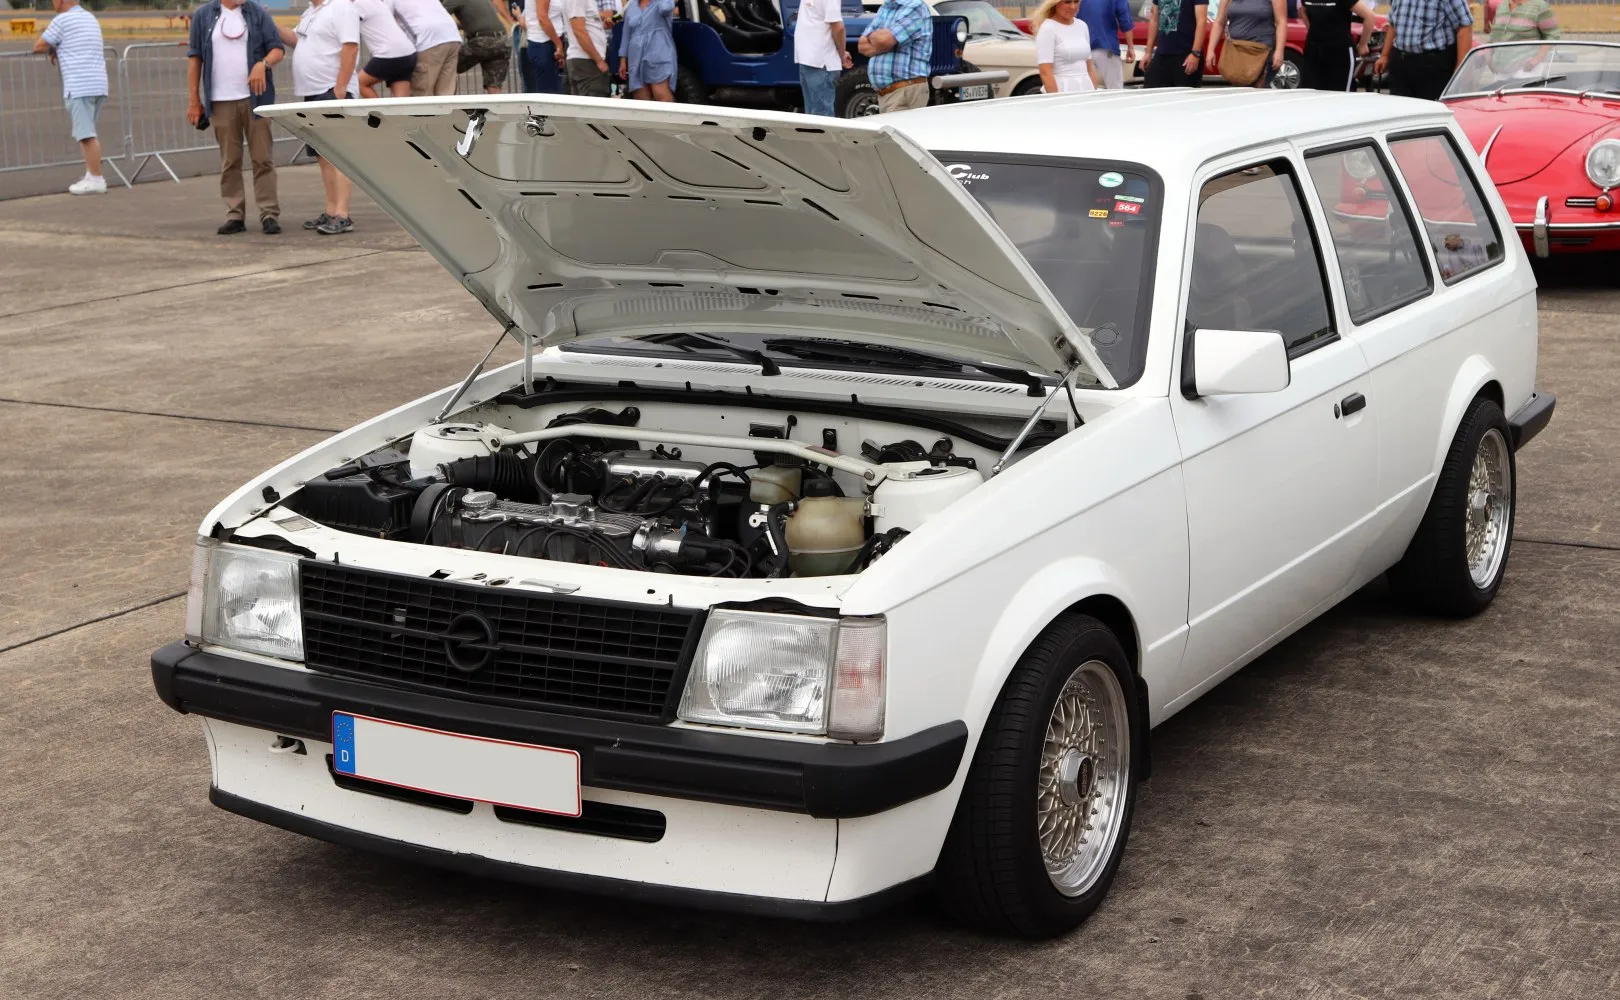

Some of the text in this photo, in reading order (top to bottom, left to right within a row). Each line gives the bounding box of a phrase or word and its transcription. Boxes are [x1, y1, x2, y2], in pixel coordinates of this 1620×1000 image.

[944, 163, 990, 180] Club
[1118, 204, 1136, 212] 564
[341, 749, 349, 762] D
